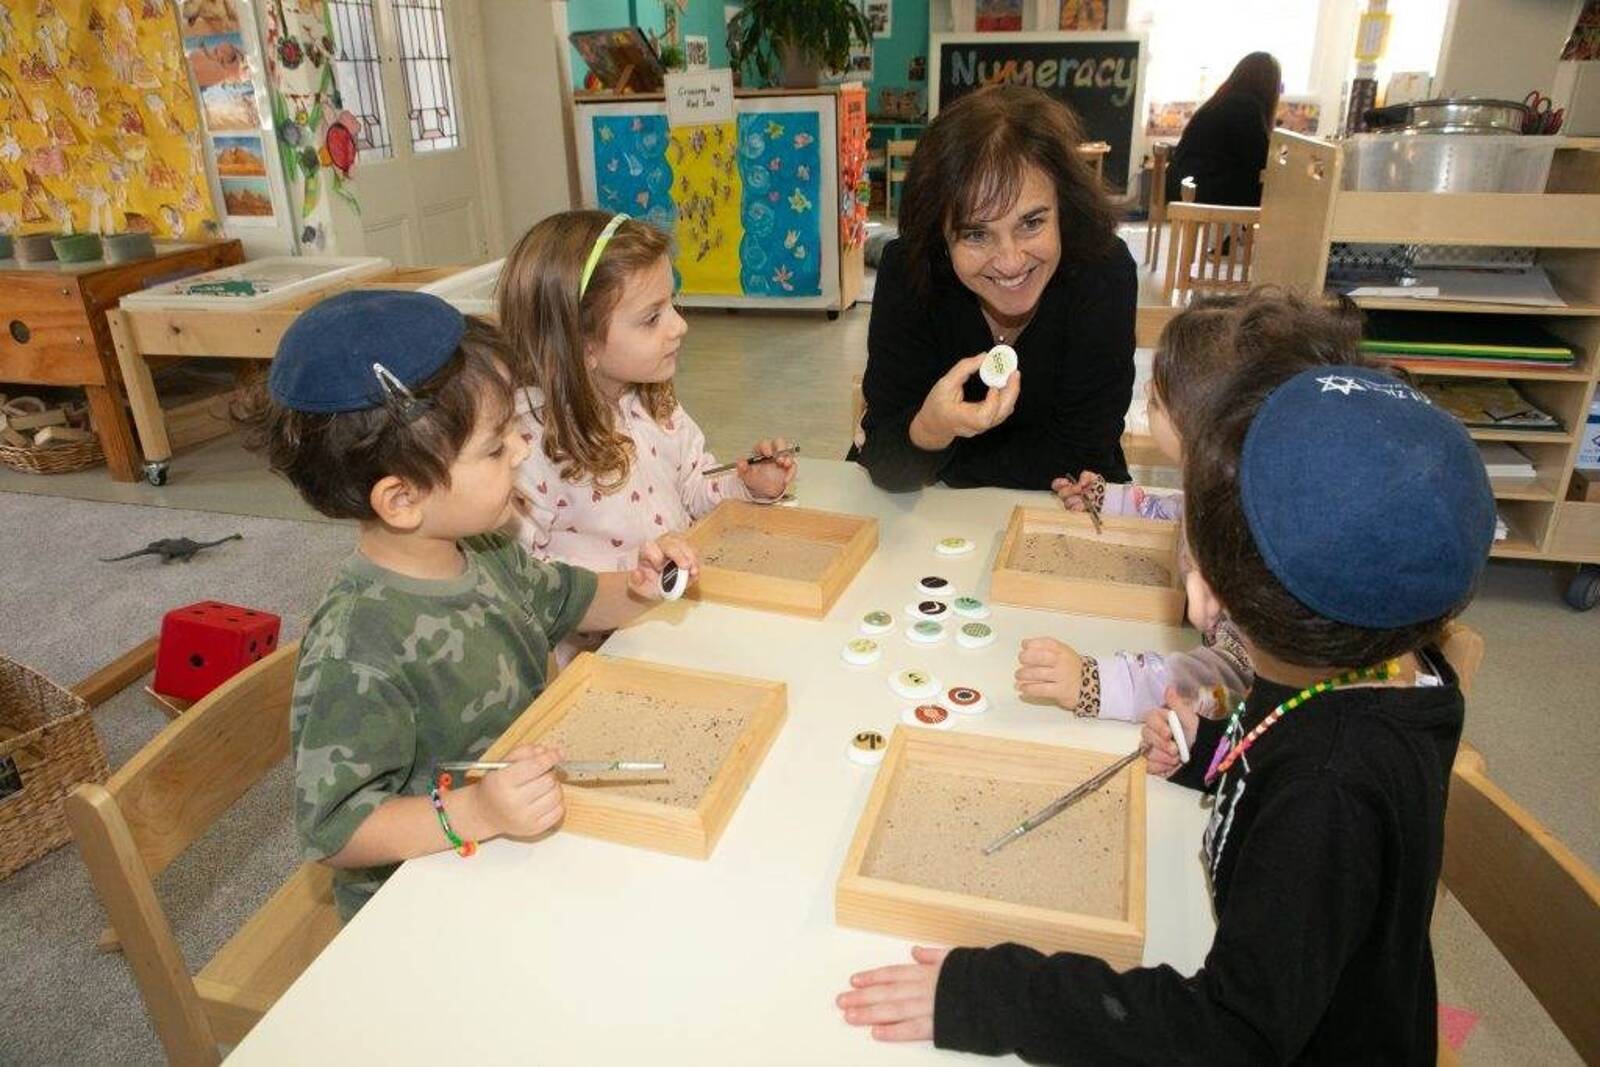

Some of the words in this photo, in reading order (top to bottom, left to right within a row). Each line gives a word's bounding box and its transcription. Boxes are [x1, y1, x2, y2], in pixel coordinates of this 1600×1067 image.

[951, 50, 1137, 107] Numeracy
[686, 99, 699, 108] Red
[703, 98, 715, 107] Sea
